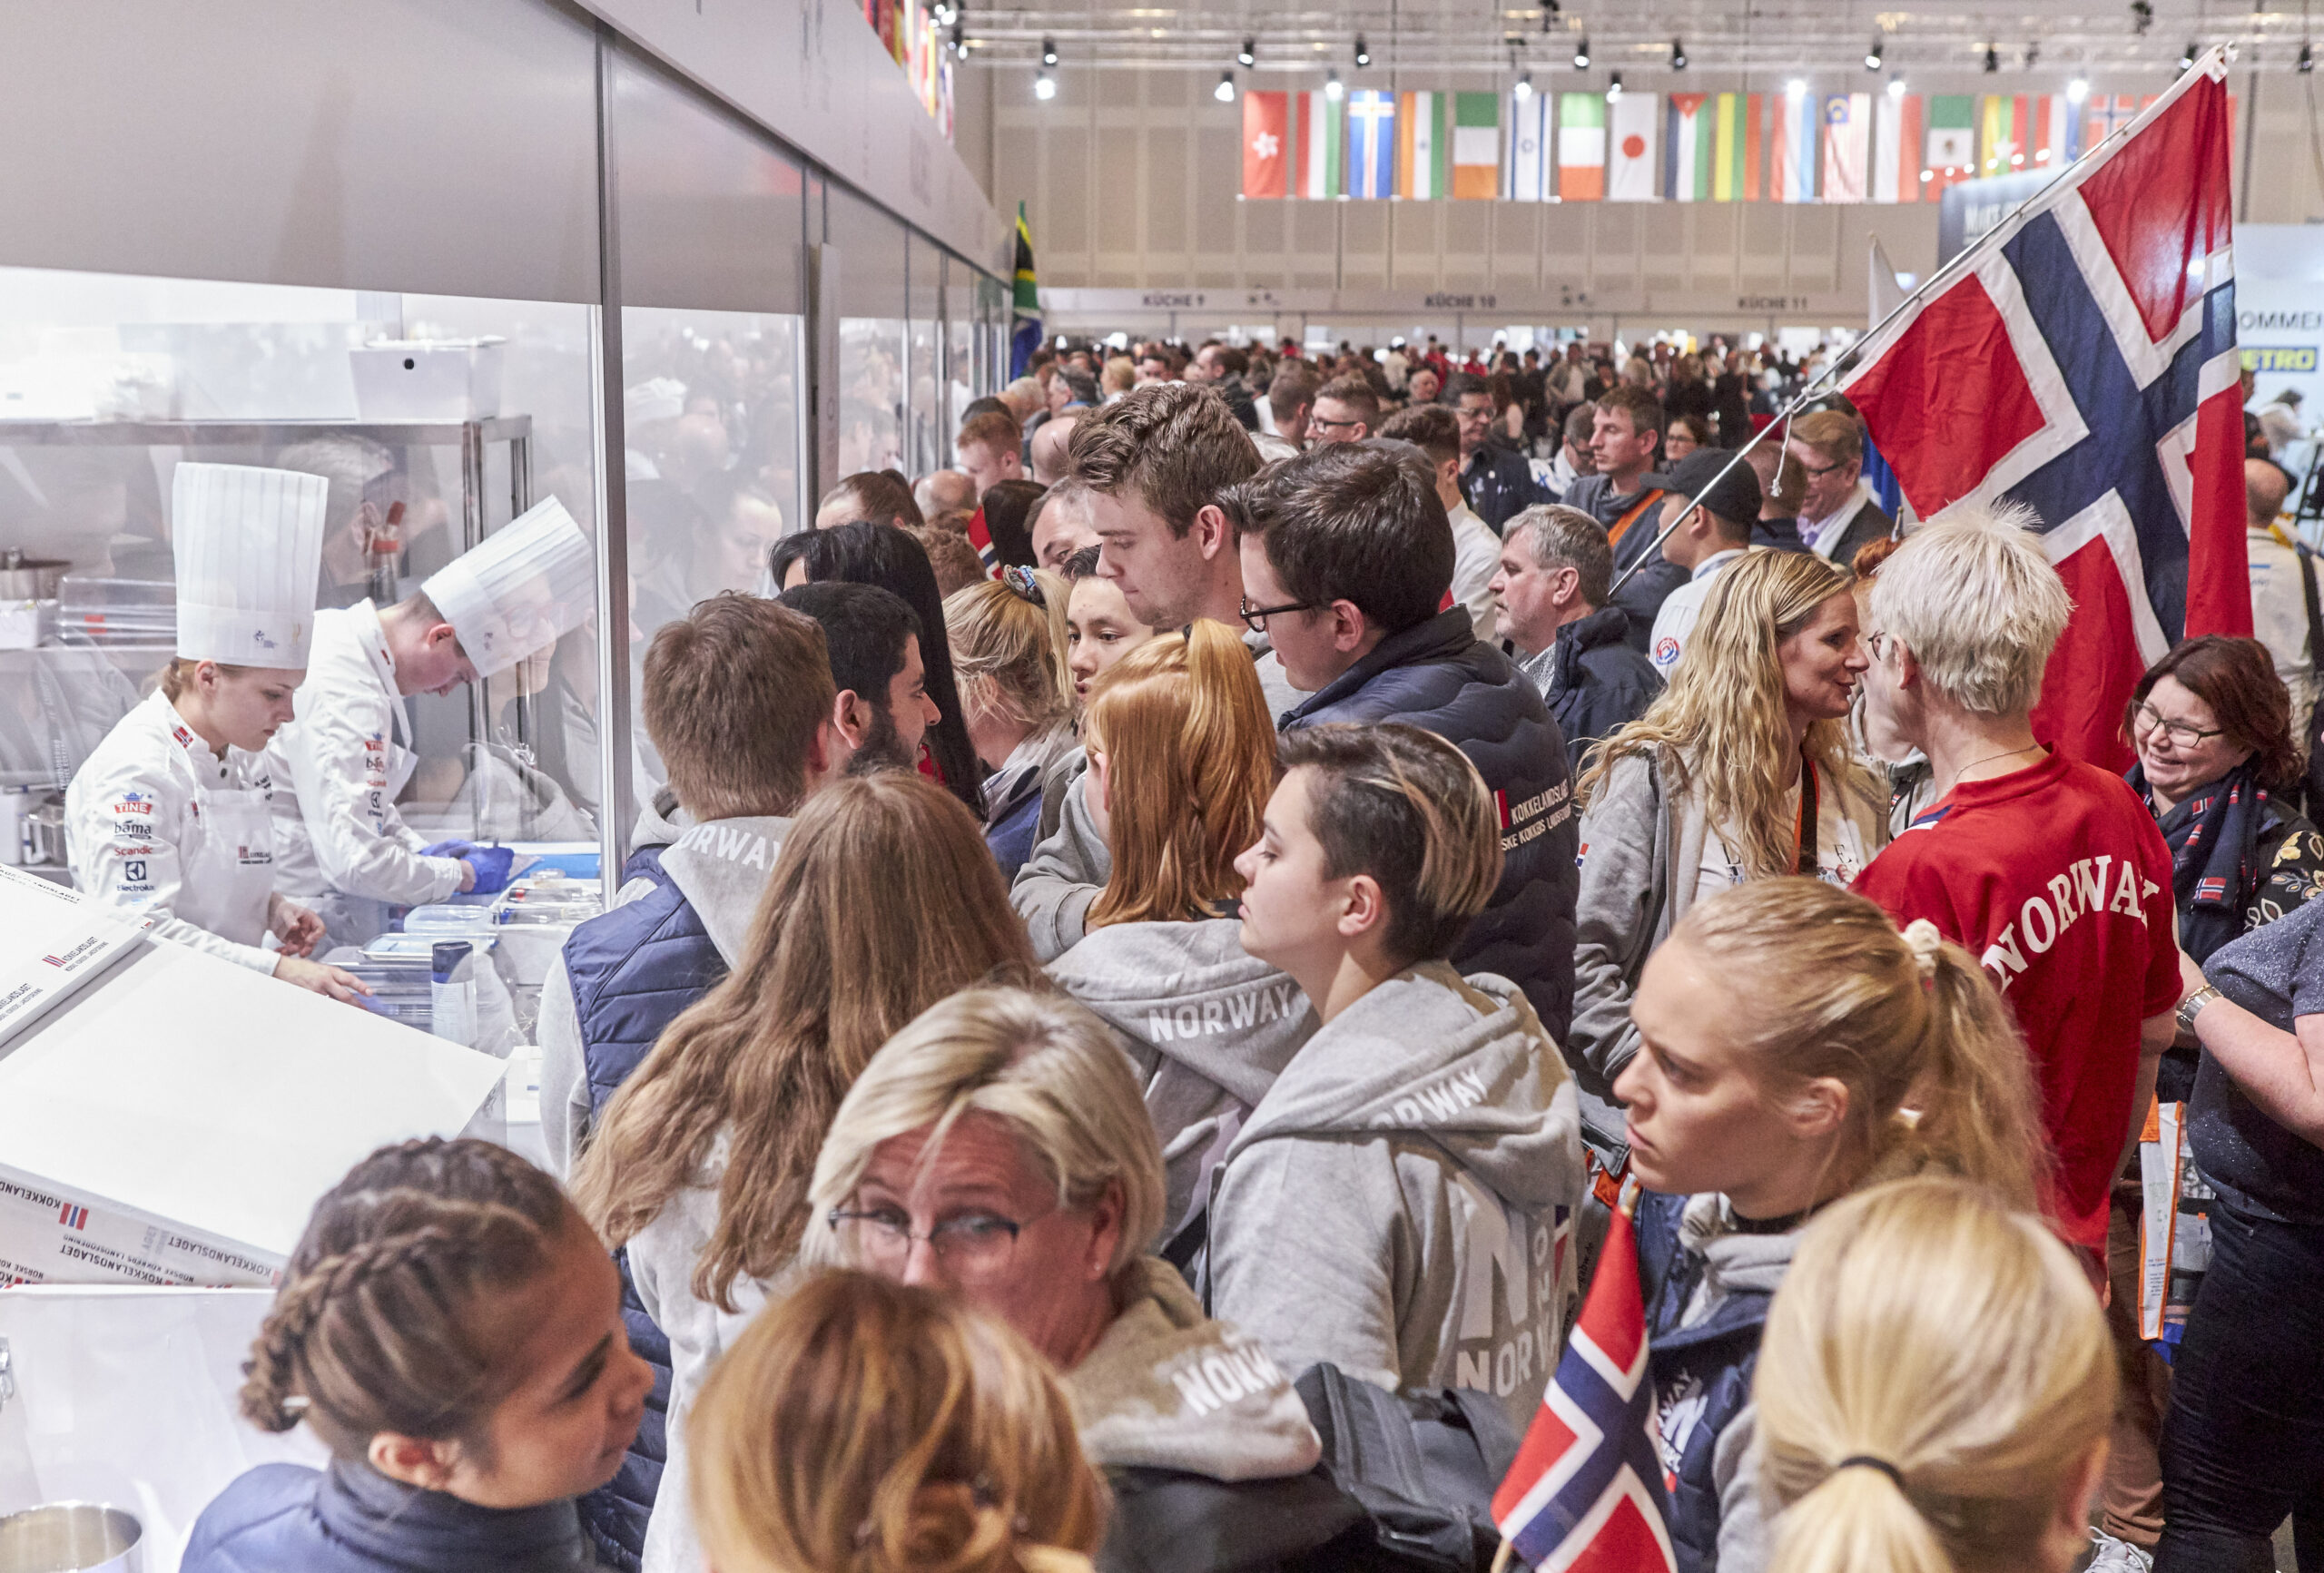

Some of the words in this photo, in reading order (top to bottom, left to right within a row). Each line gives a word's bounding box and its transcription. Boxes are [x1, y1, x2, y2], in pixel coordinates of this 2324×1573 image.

[2239, 310, 2324, 329] OMME
[2240, 348, 2316, 370] ETRO
[116, 802, 149, 813] TINE
[114, 845, 153, 856] Scandic
[676, 824, 781, 873] ORWAY
[1501, 833, 1519, 851] SKE
[1979, 853, 2161, 996] NORWAY
[1147, 982, 1292, 1044] NORWAY
[0, 1182, 61, 1210] KOKKELAND
[59, 1244, 163, 1285] KOKKELANDSLAGET
[168, 1236, 271, 1277] KOKKELANDSLAGET
